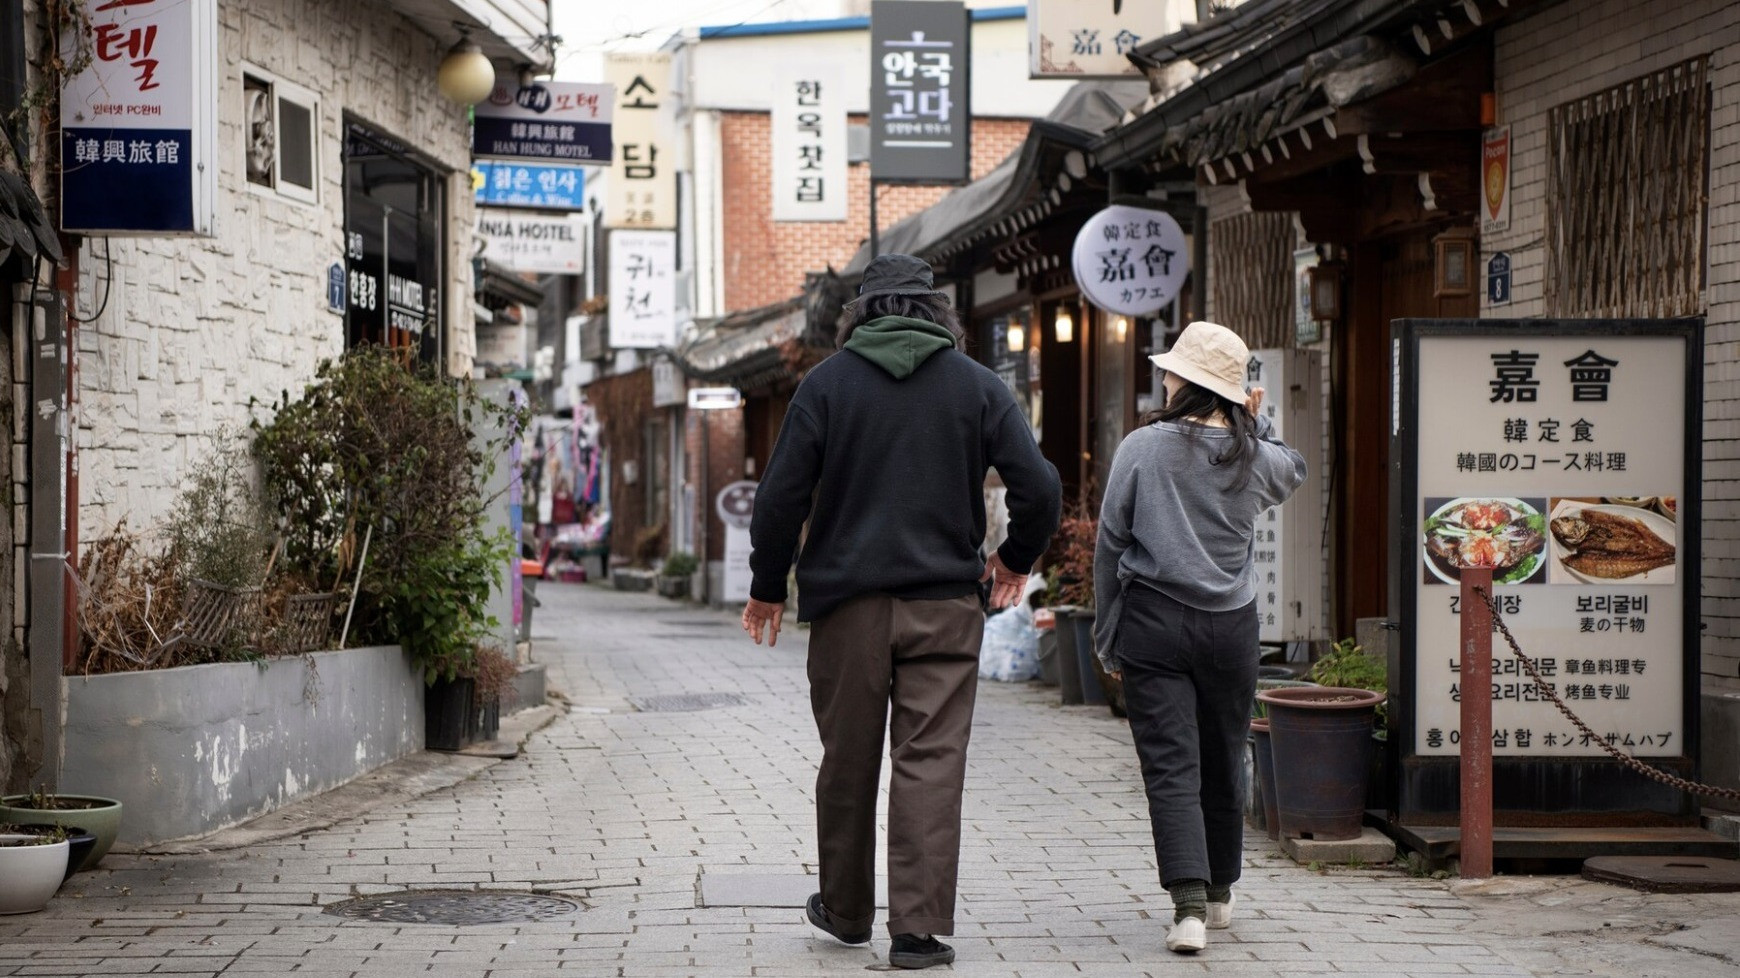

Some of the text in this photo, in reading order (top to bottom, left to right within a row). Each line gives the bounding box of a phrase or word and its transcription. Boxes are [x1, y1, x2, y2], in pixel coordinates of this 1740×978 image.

[93, 0, 160, 91] 텔
[882, 51, 953, 87] 안국
[93, 104, 161, 116] 인터넷 PC완비
[554, 93, 600, 118] 모텔
[882, 88, 953, 122] 고다
[621, 74, 659, 179] 소담
[75, 138, 179, 164] 韓興旅館
[493, 141, 592, 158] HAN HUNG MOTEL
[796, 80, 823, 202] 한옥찻집
[519, 222, 576, 242] HOSTEL
[1103, 218, 1162, 242] 韓定食
[1095, 243, 1177, 283] 嘉會
[1495, 277, 1503, 299] 8
[1489, 350, 1619, 403] 嘉會
[1504, 418, 1594, 443] 韓定食
[1457, 452, 1626, 472] 韓國のコース料理
[1576, 595, 1648, 614] 보리굴비
[1580, 617, 1645, 633] 麦の干物
[1565, 659, 1647, 675] 章鱼料理专
[1565, 684, 1630, 700] 烤鱼专业
